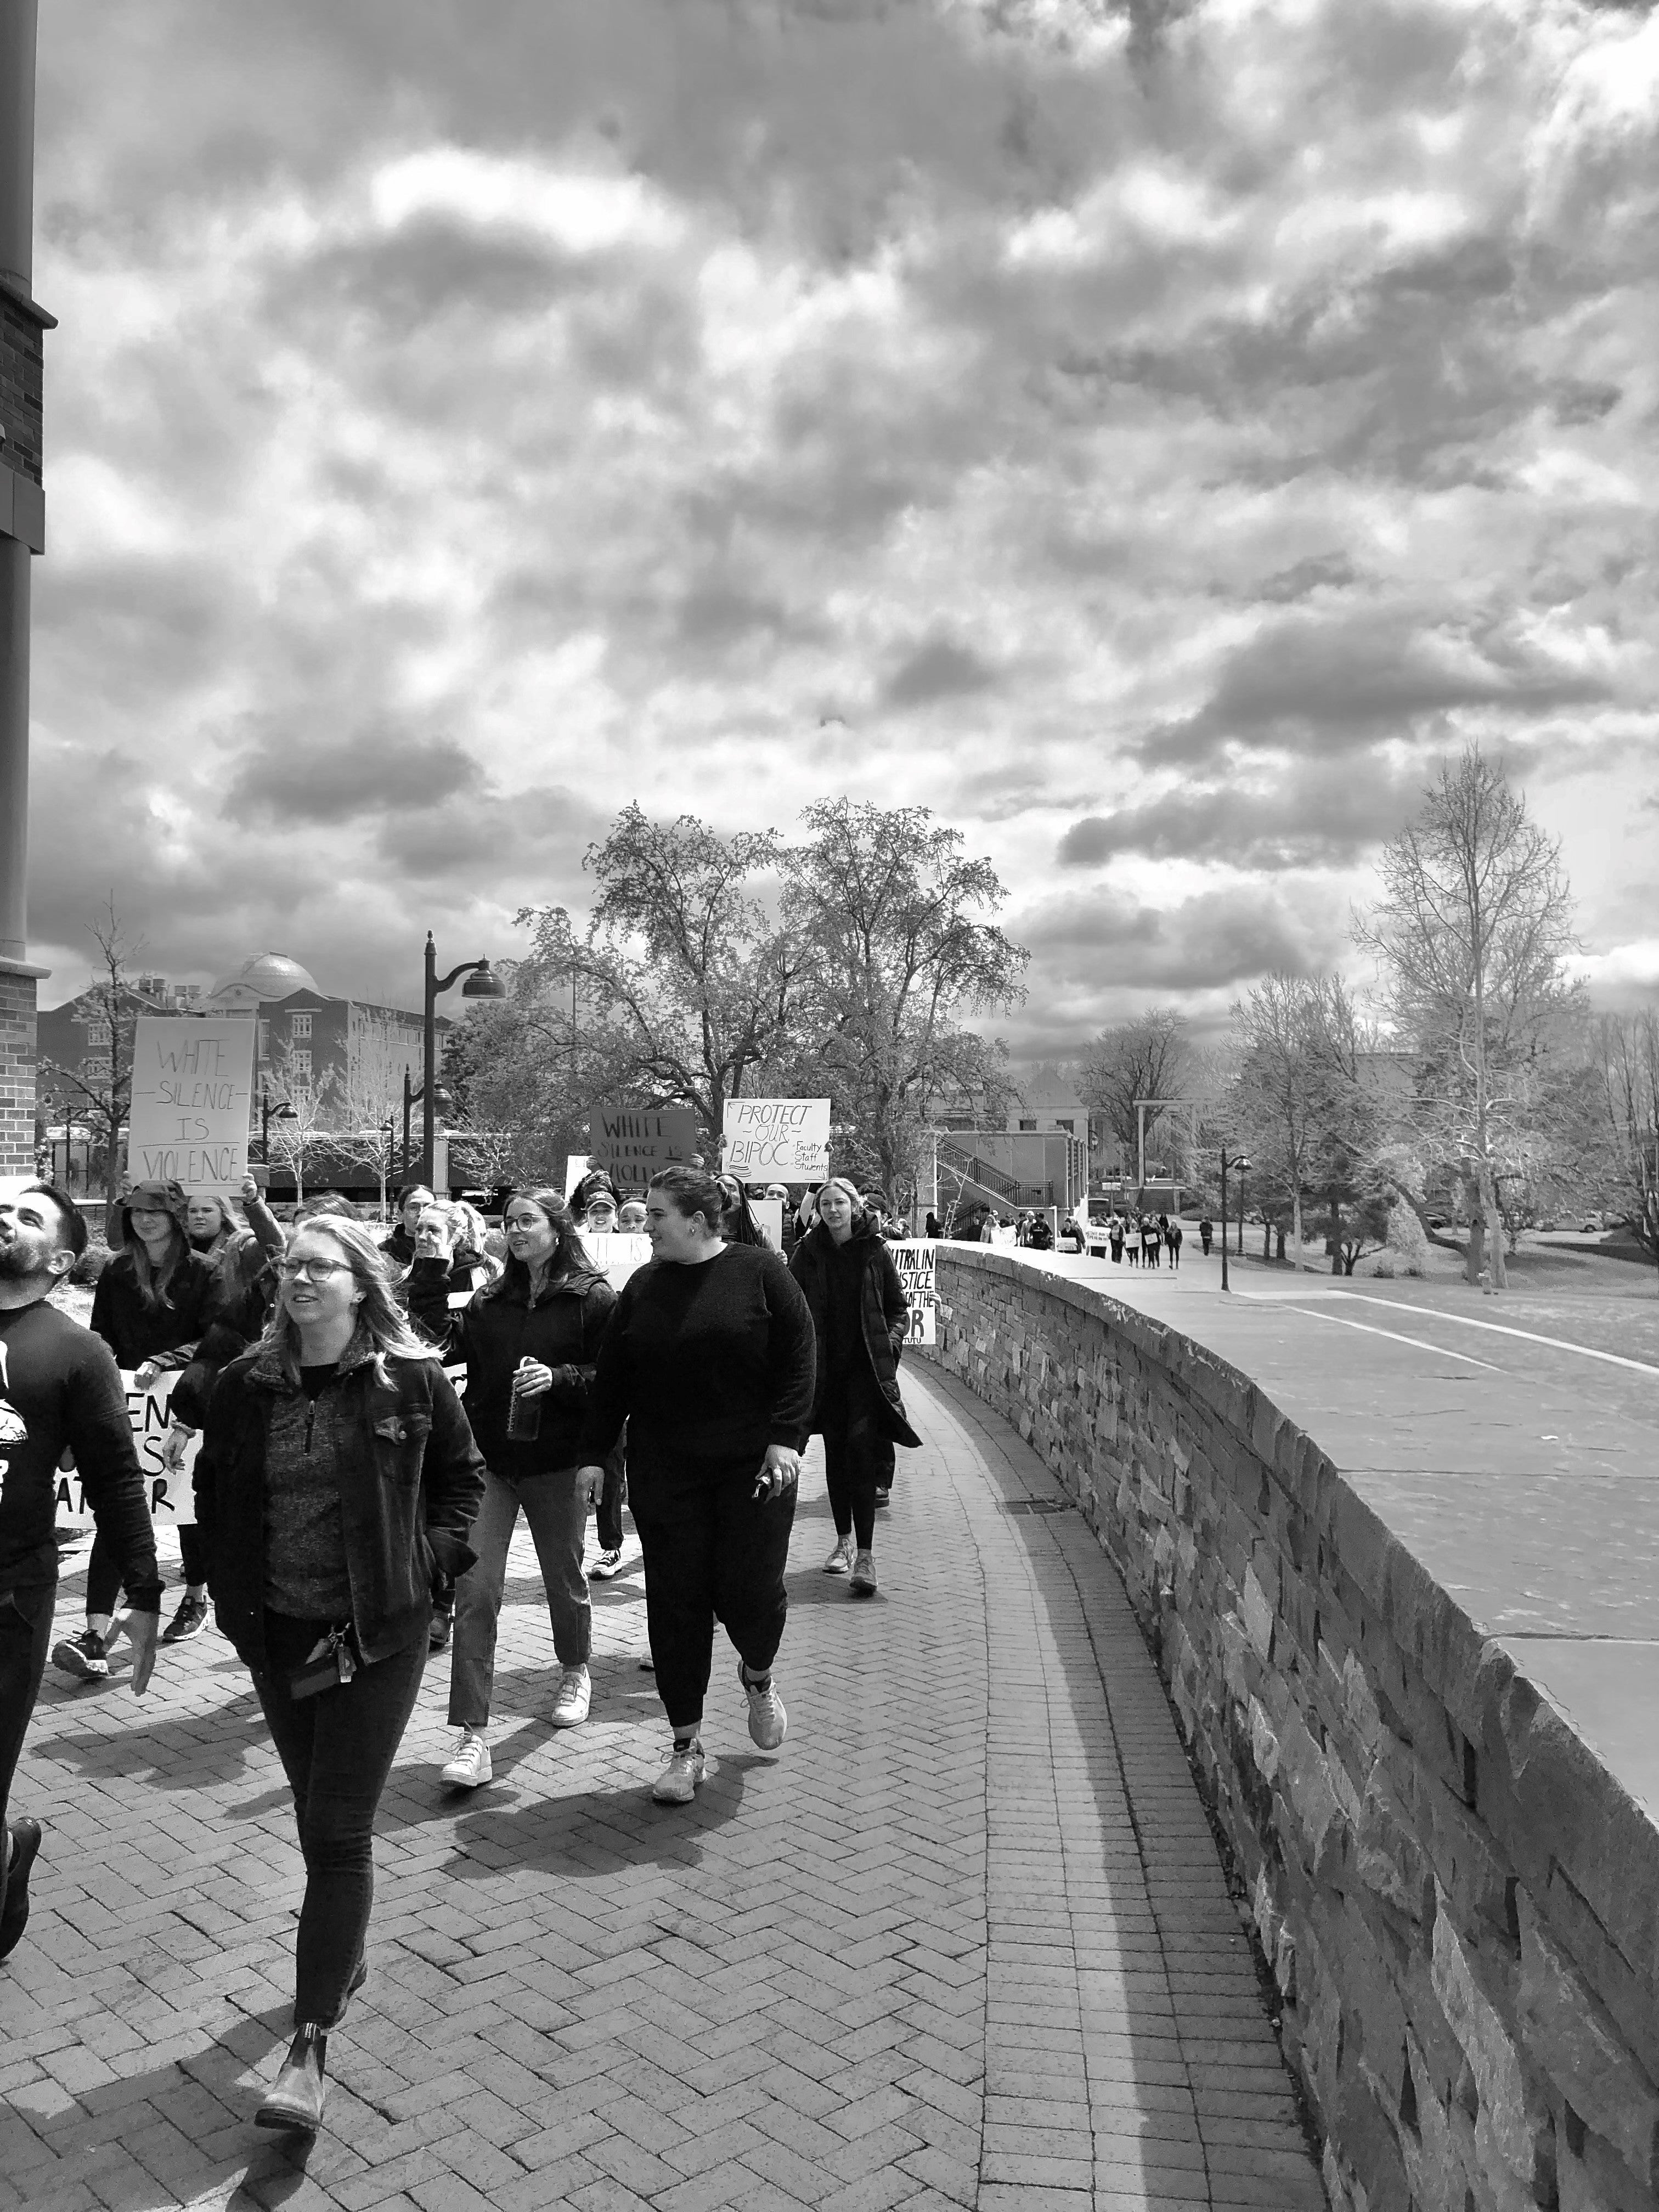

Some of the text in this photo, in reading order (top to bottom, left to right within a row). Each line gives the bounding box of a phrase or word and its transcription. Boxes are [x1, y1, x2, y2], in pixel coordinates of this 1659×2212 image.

[156, 1039, 230, 1076] WHITE
[737, 1104, 812, 1125] PROTECT
[175, 1118, 210, 1141] IS
[601, 1113, 672, 1138] WHITE
[755, 1124, 789, 1142] OUR
[597, 1142, 682, 1158] SILENCE IS
[730, 1140, 789, 1166] BIPOC
[795, 1150, 818, 1162] Staff
[797, 1141, 822, 1153] Faculty
[143, 1147, 238, 1182] VIOLENCE
[794, 1160, 828, 1171] Students
[900, 1270, 934, 1290] STICE
